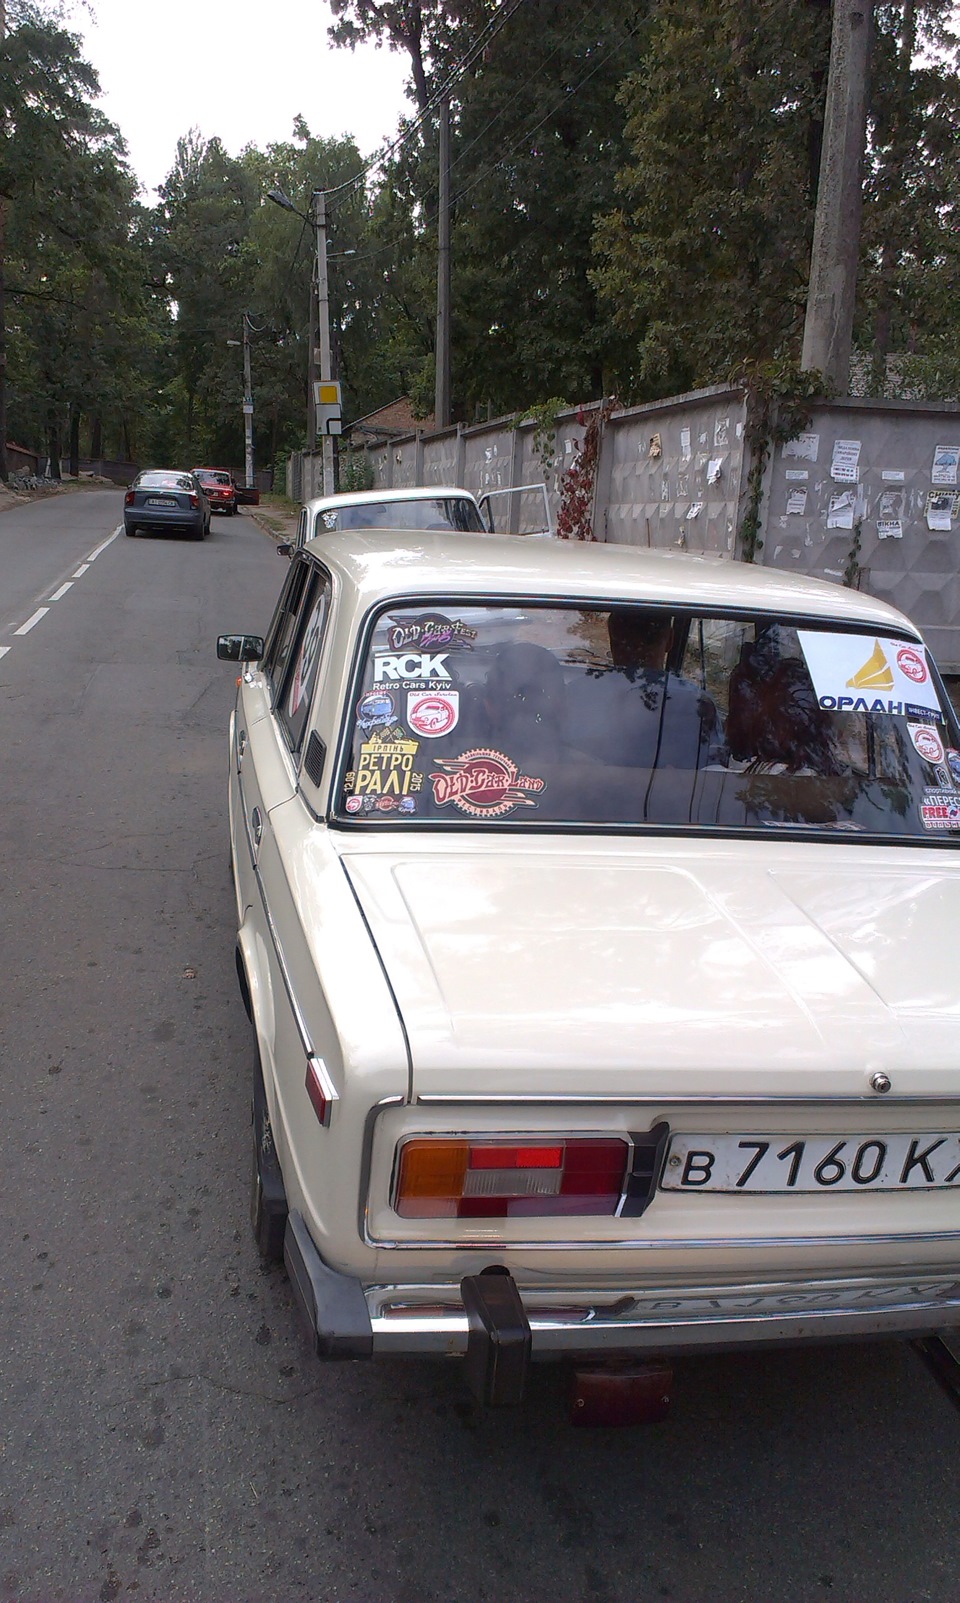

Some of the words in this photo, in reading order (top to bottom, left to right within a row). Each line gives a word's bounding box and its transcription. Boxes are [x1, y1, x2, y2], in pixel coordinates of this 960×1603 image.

[373, 652, 453, 682] RCK
[373, 682, 399, 690] Retro
[402, 681, 426, 689] Cars
[428, 680, 452, 690] Kyiv
[819, 696, 903, 715] ОРЛАН
[358, 753, 414, 771] РЕТРО
[354, 769, 411, 795] РАЛІ
[410, 772, 423, 791] 2015
[735, 1139, 888, 1188] 7160
